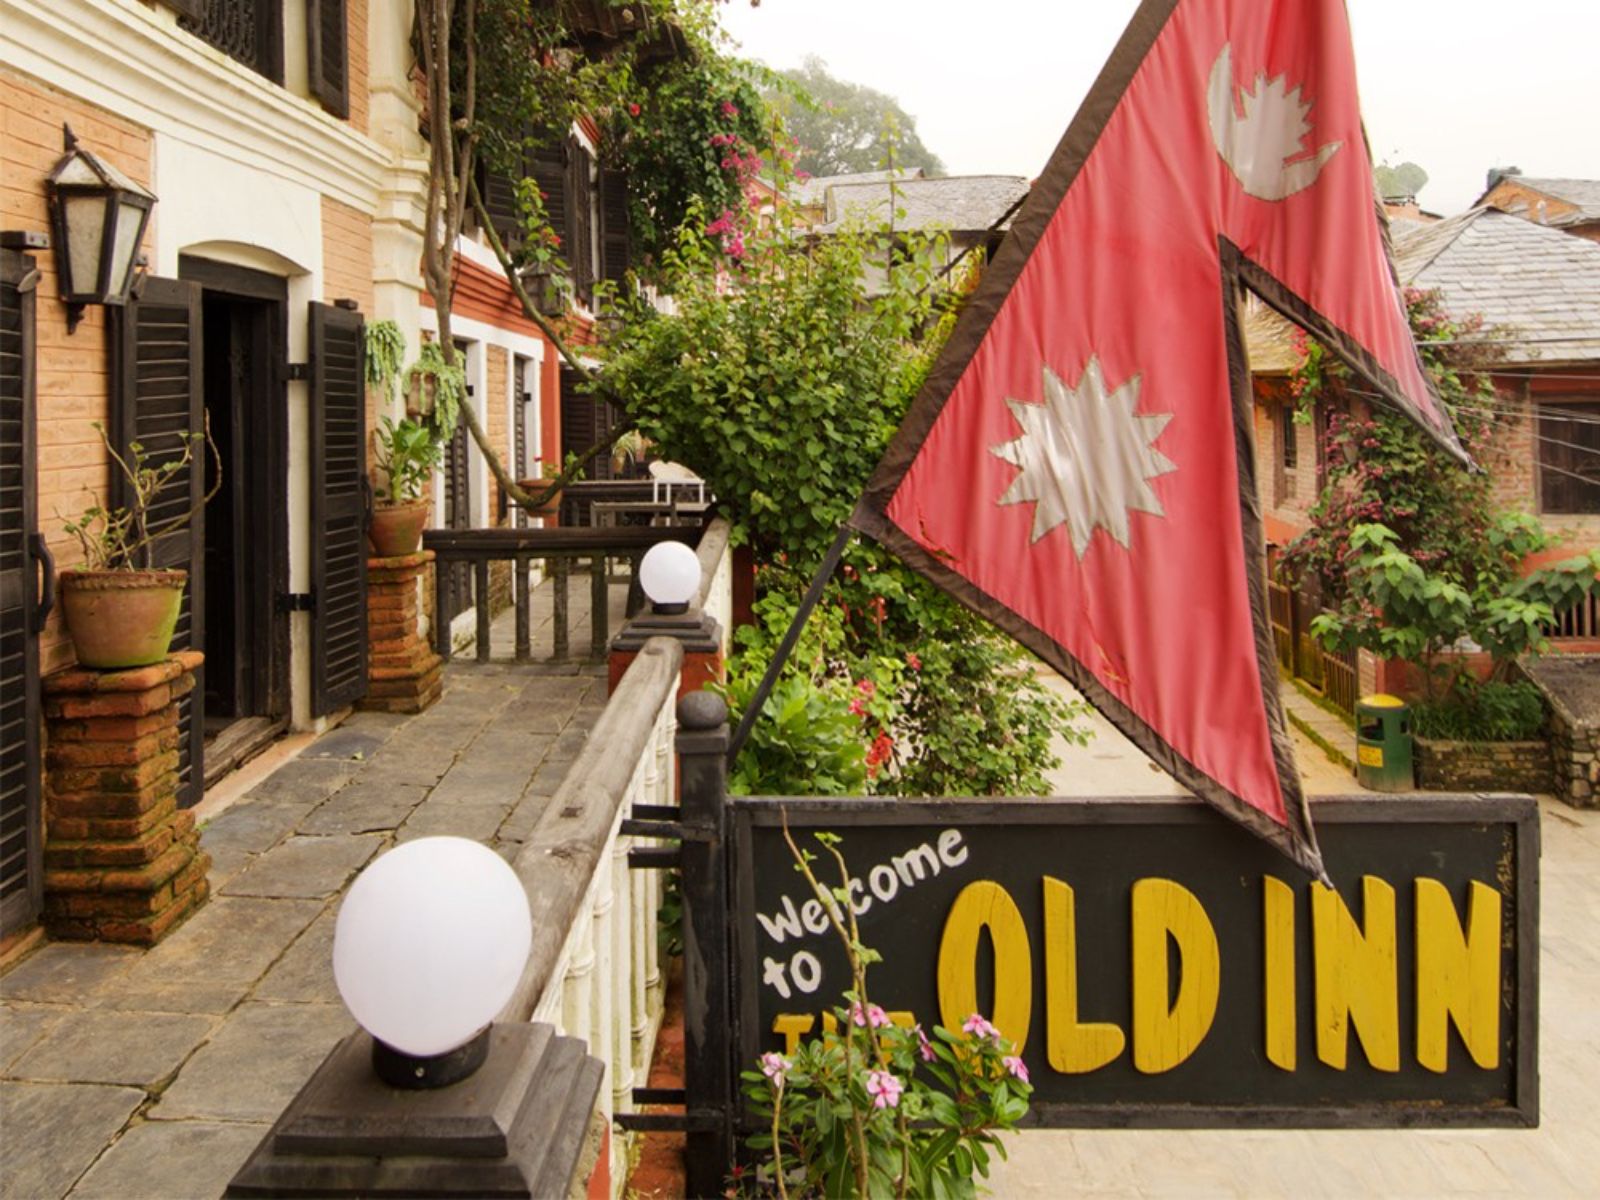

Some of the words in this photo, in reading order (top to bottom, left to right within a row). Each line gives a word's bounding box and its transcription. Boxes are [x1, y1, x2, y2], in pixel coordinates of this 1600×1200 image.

[756, 828, 969, 943] Welcome
[763, 951, 822, 998] to
[937, 876, 1221, 1074] OLD
[1264, 873, 1501, 1073] INN
